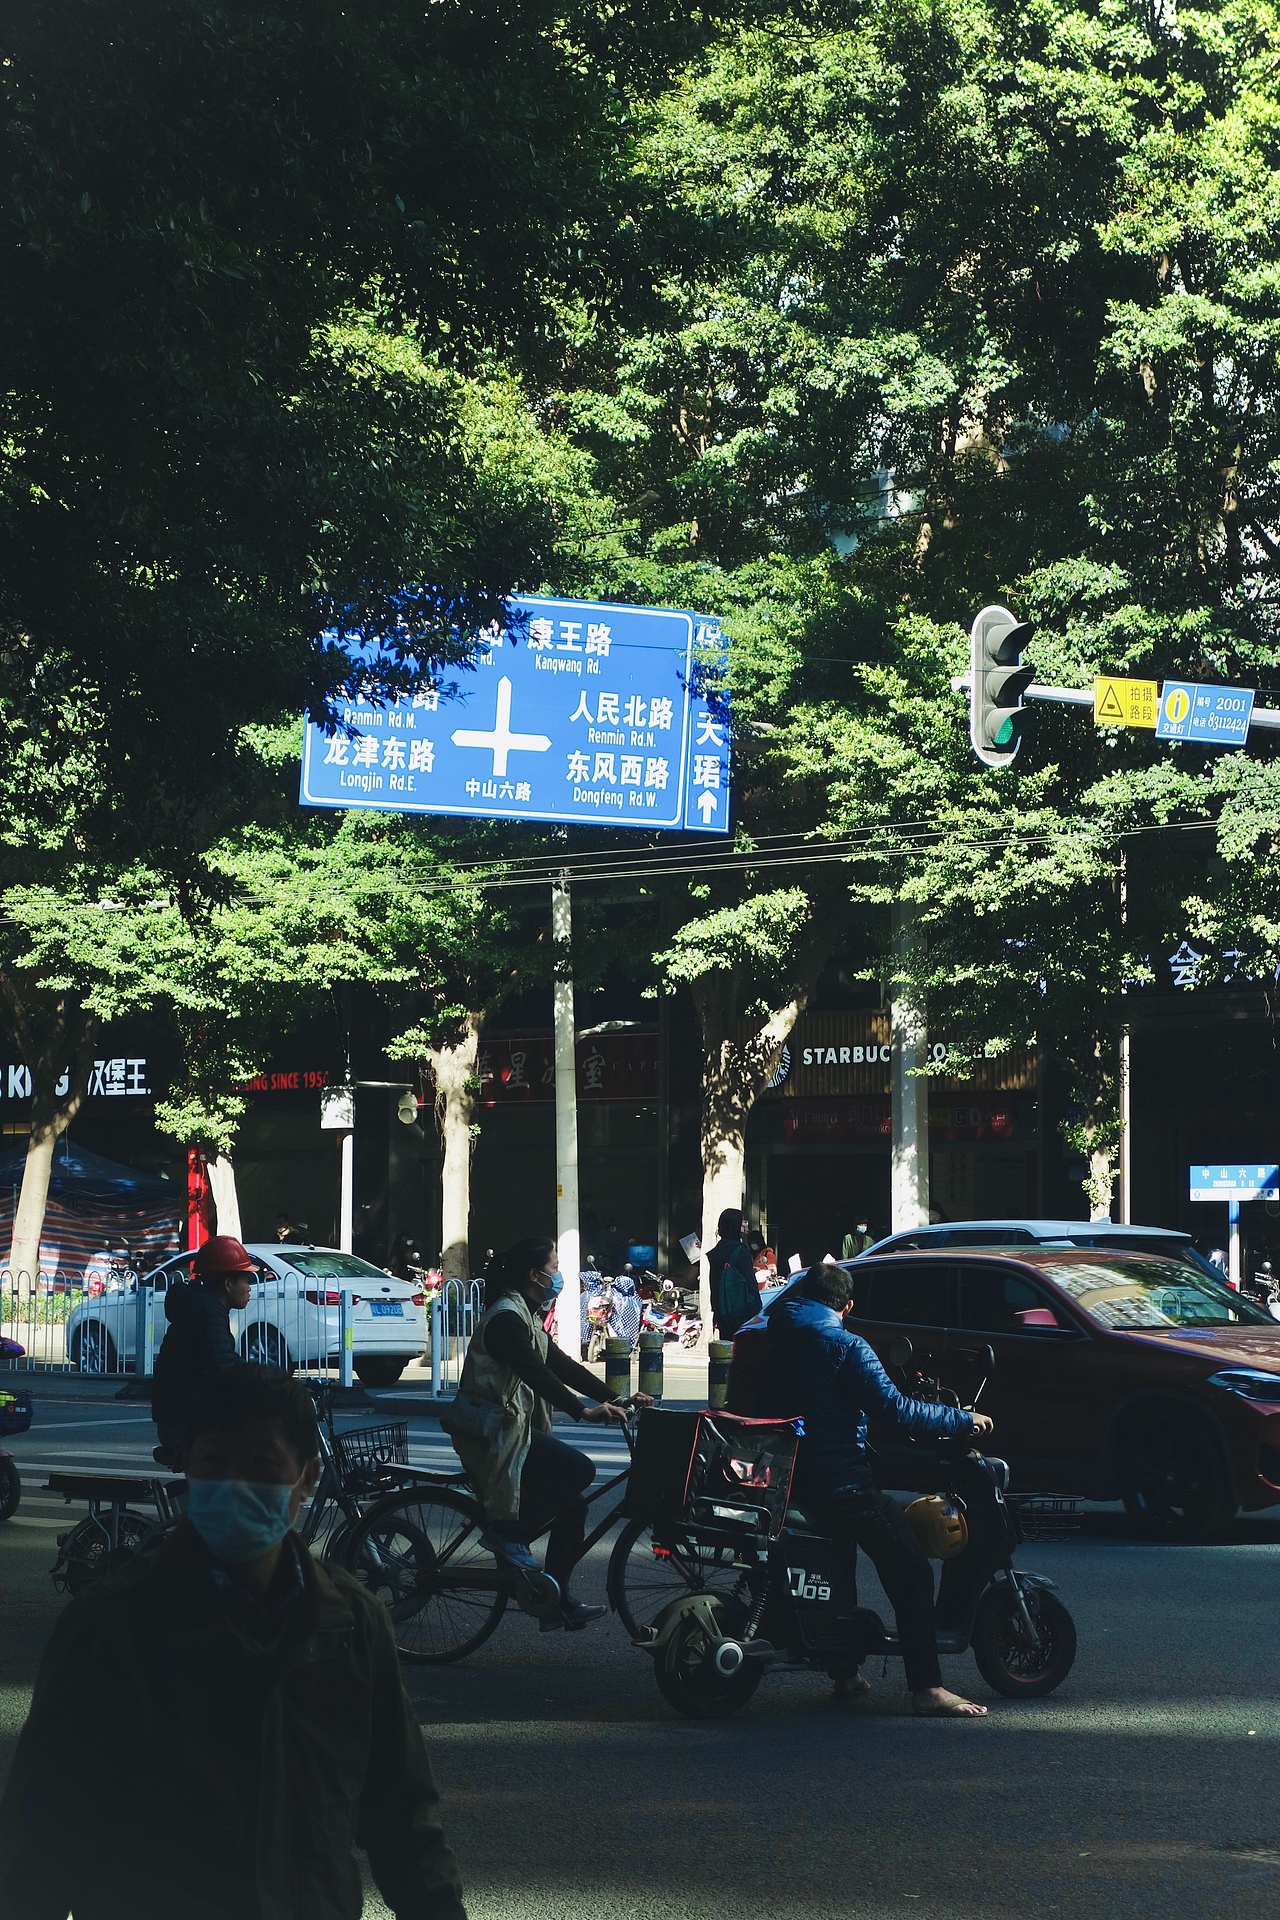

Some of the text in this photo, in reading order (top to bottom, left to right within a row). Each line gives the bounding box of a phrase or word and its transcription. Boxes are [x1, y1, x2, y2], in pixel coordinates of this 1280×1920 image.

[527, 617, 613, 657] 康王路
[535, 653, 602, 678] Kangwang Rd.
[693, 619, 724, 790] 天珺
[1130, 685, 1154, 702] 拍摄
[569, 689, 674, 731] 人民北路
[1130, 704, 1154, 721] 路段
[1216, 697, 1246, 713] 2001
[344, 708, 417, 729] Renmin Rd.M.
[1161, 722, 1185, 736] 交通灯
[1207, 711, 1247, 735] 83112424
[588, 727, 657, 749] Renmin Rd.N.
[323, 736, 436, 774] 龙津东路
[566, 750, 671, 790] 东风西路
[340, 771, 418, 793] Longjin Rd.E.
[464, 776, 533, 802] 中山六路
[572, 786, 659, 809] Dongfeng Rd.W.
[802, 1044, 891, 1066] STARBUC
[7, 1063, 70, 1099] KIG
[270, 1071, 299, 1091] SINCE
[848, 1104, 890, 1122] 西门口
[1201, 1167, 1266, 1180] 中山六路
